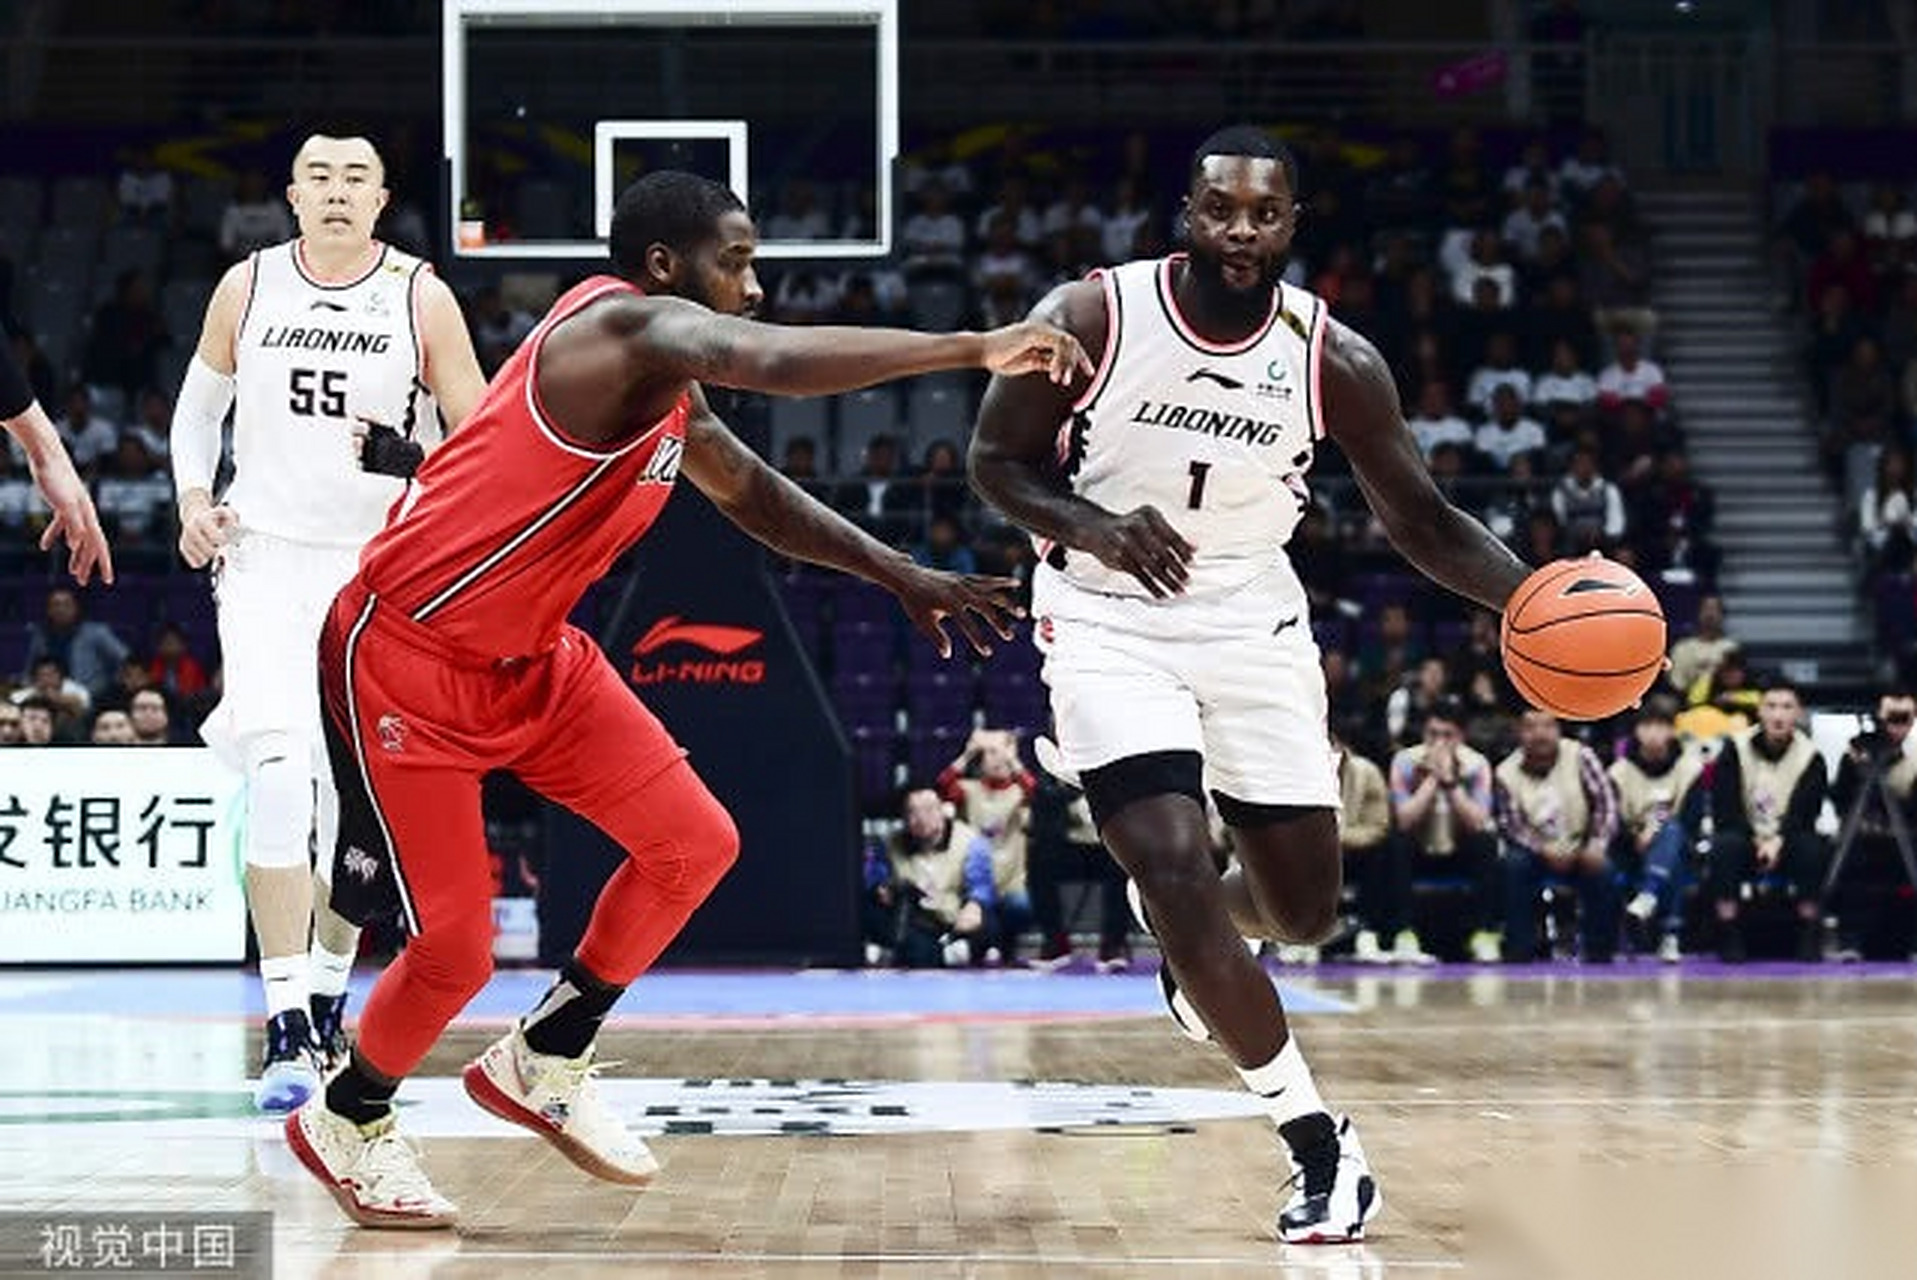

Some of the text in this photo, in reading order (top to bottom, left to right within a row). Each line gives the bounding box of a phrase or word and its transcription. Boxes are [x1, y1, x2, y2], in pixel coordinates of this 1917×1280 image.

[261, 326, 392, 356] LIAONING
[289, 368, 348, 418] 55
[1131, 401, 1283, 446] LIAONING
[1187, 460, 1212, 510] 1
[632, 660, 765, 684] LI-NING
[129, 889, 213, 912] BANK
